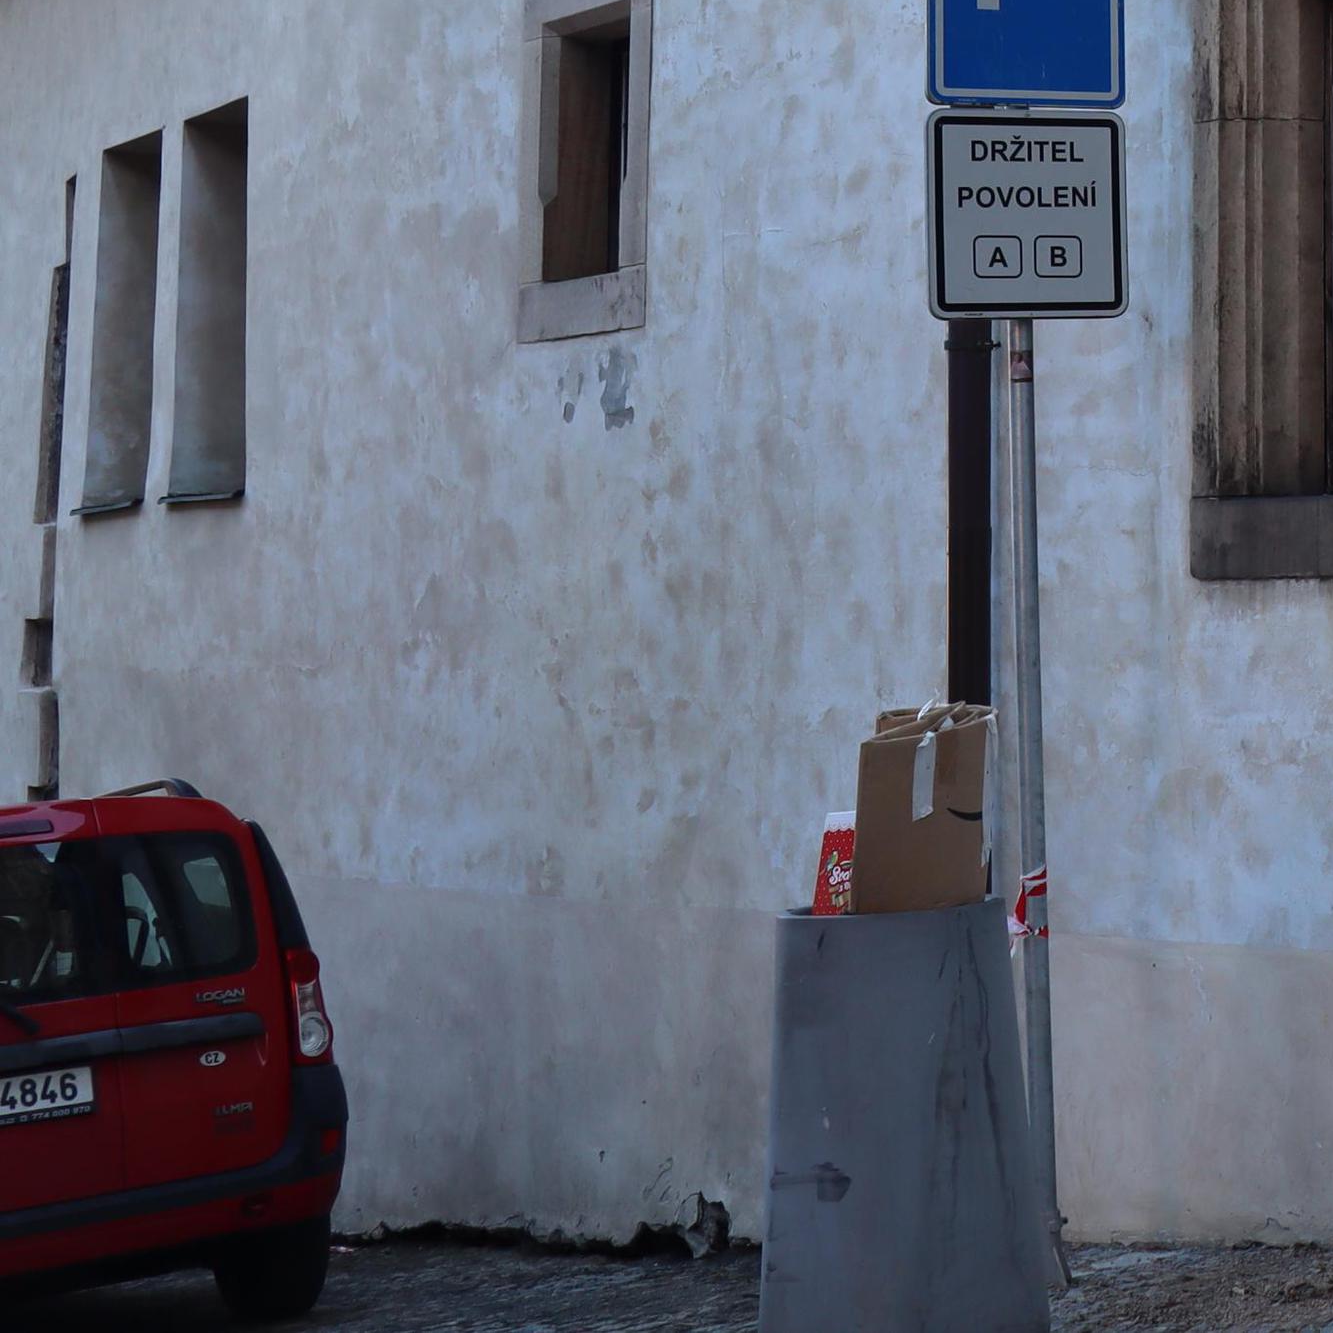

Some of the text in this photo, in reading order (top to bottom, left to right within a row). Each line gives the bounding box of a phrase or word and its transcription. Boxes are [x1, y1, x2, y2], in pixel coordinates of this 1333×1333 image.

[970, 135, 1084, 163] DRŽITEL
[957, 181, 1097, 209] POVOLENÍ
[988, 246, 1068, 268] A B
[196, 987, 245, 1002] LOGAN
[204, 1052, 220, 1064] CZ
[0, 1072, 78, 1110] 4846
